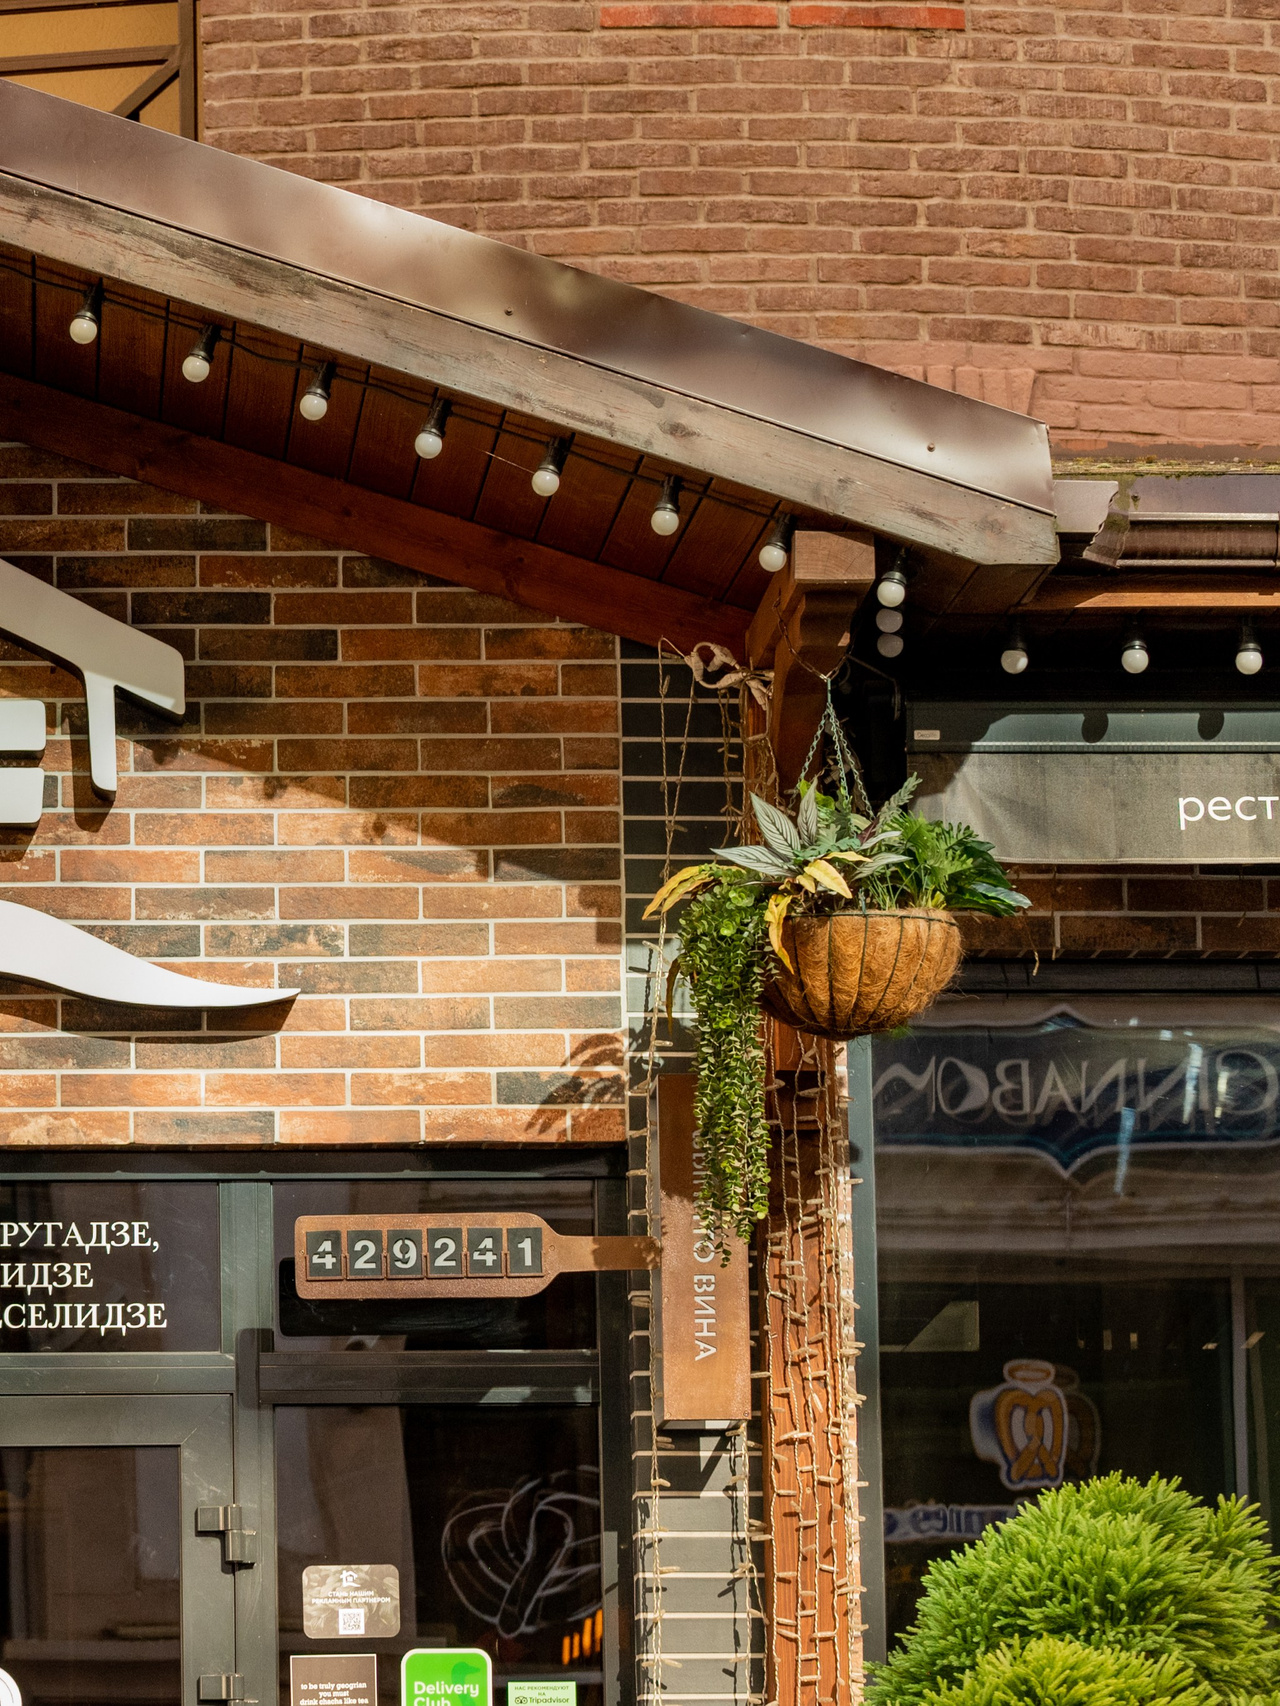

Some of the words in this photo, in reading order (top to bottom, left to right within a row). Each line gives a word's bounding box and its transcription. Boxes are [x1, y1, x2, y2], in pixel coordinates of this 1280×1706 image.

[1179, 796, 1280, 830] рест
[0, 1222, 160, 1254] РУГАДЗЕ,
[693, 1274, 717, 1361] ВИНА
[319, 1682, 335, 1690] truly
[414, 1681, 479, 1697] Delivery
[300, 1698, 318, 1706] drink
[529, 1696, 569, 1704] Tripadvisor
